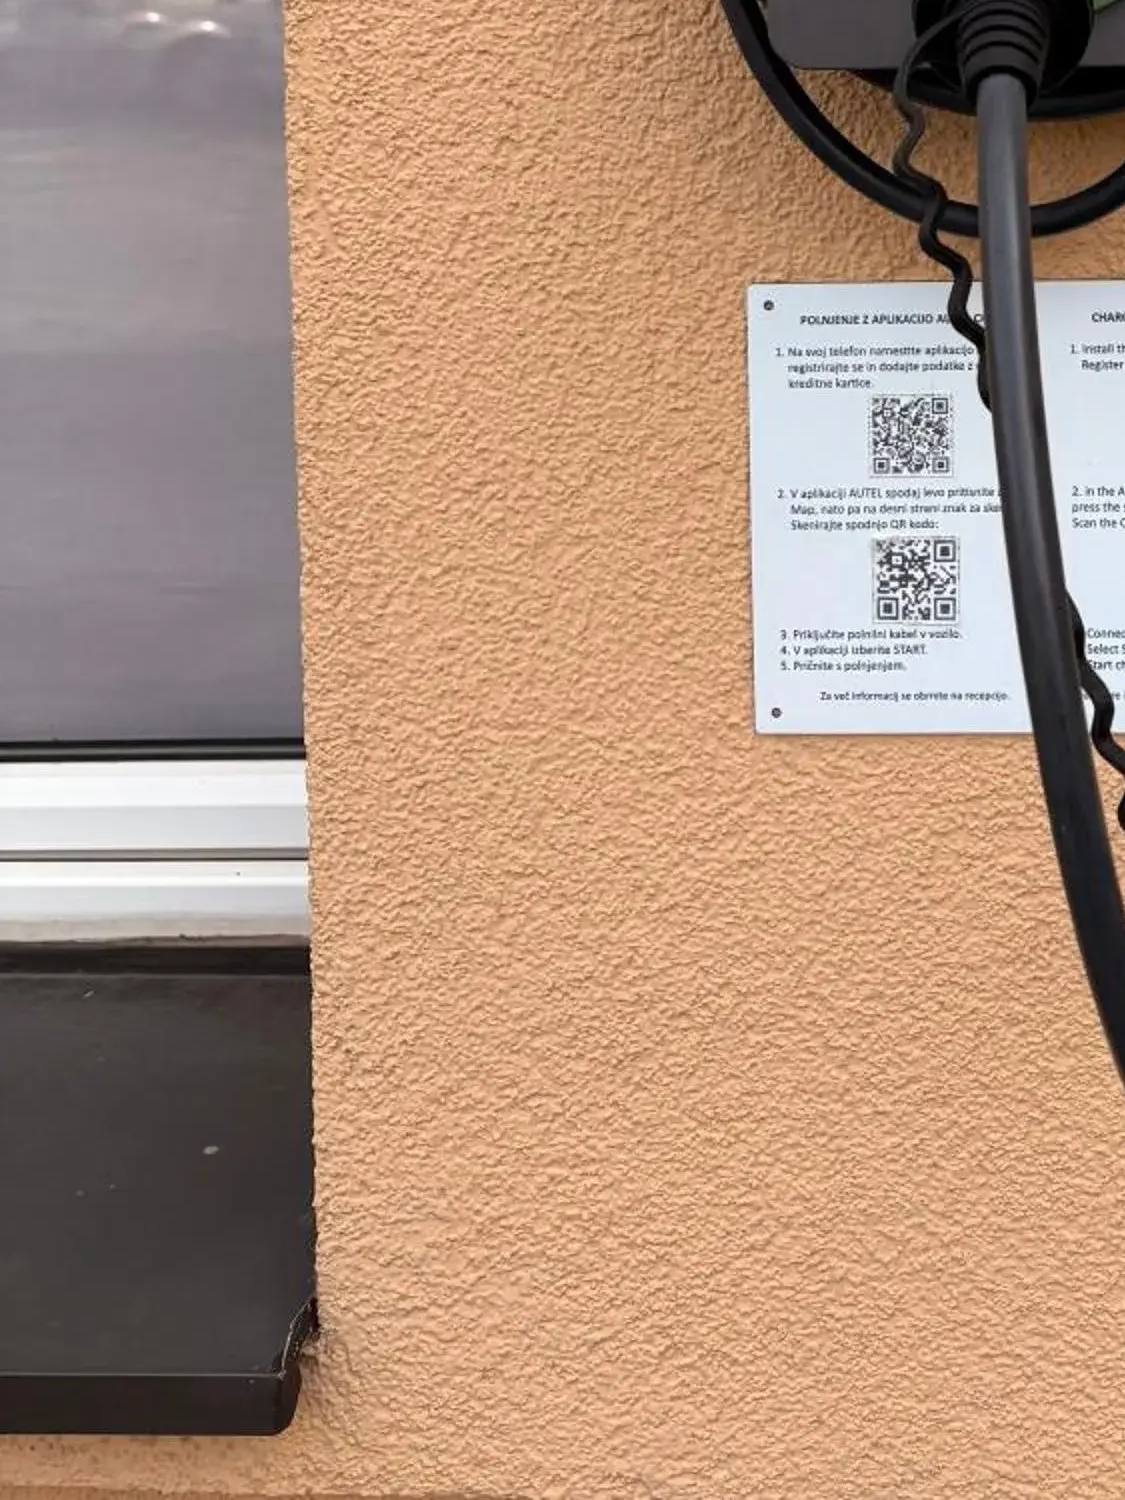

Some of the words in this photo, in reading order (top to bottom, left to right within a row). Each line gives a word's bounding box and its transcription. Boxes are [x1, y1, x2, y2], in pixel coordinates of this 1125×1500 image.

[805, 347, 827, 358] svoj
[829, 344, 867, 356] telefon
[924, 344, 975, 356] aplikacijo
[1081, 343, 1115, 354] Install
[787, 363, 849, 376] registrirajte
[879, 362, 919, 373] dodajte
[922, 360, 965, 372] podatke
[1081, 360, 1124, 372] Register
[788, 378, 833, 388] kreditne
[801, 488, 847, 500] aplikaciji
[849, 487, 883, 499] AUTEL
[885, 487, 921, 500] spodaj
[923, 487, 945, 500] levo
[1097, 486, 1115, 497] the
[821, 505, 845, 514] nato
[879, 504, 908, 514] desni
[1071, 503, 1101, 514] press
[1102, 502, 1121, 512] the
[790, 520, 843, 532] Skenirajte
[845, 520, 888, 532] spodnjo
[909, 518, 940, 529] kodo:
[1071, 518, 1097, 528] Scan
[1099, 518, 1118, 528] the
[793, 629, 845, 642] Priključite
[889, 629, 918, 639] kabel
[803, 645, 849, 657] aplikaciji
[1087, 643, 1119, 655] Select
[793, 660, 834, 670] Pričnite
[834, 692, 850, 700] več
